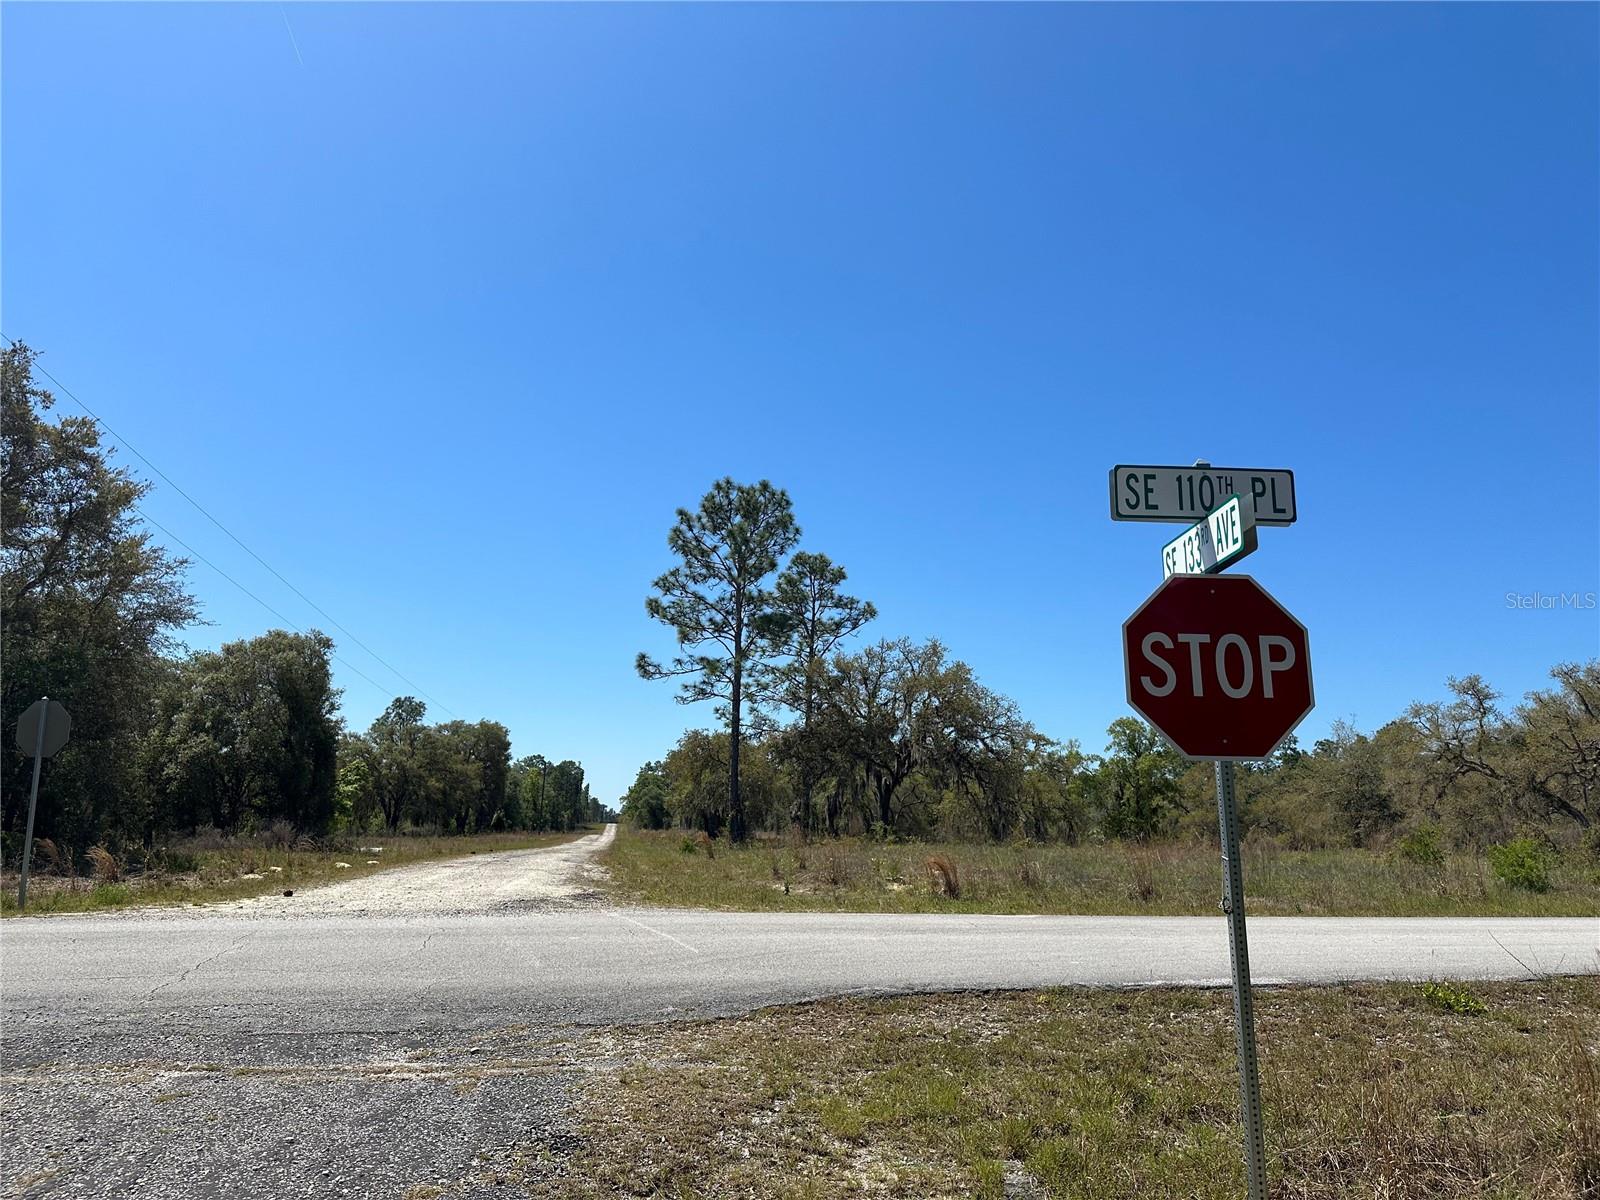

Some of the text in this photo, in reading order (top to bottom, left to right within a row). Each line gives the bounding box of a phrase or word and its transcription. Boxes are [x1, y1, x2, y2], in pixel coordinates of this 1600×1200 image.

[1125, 473, 1286, 514] SE 110TH PL
[1183, 525, 1209, 573] 133RD
[1216, 505, 1239, 556] AVE
[1140, 631, 1296, 699] STOP
